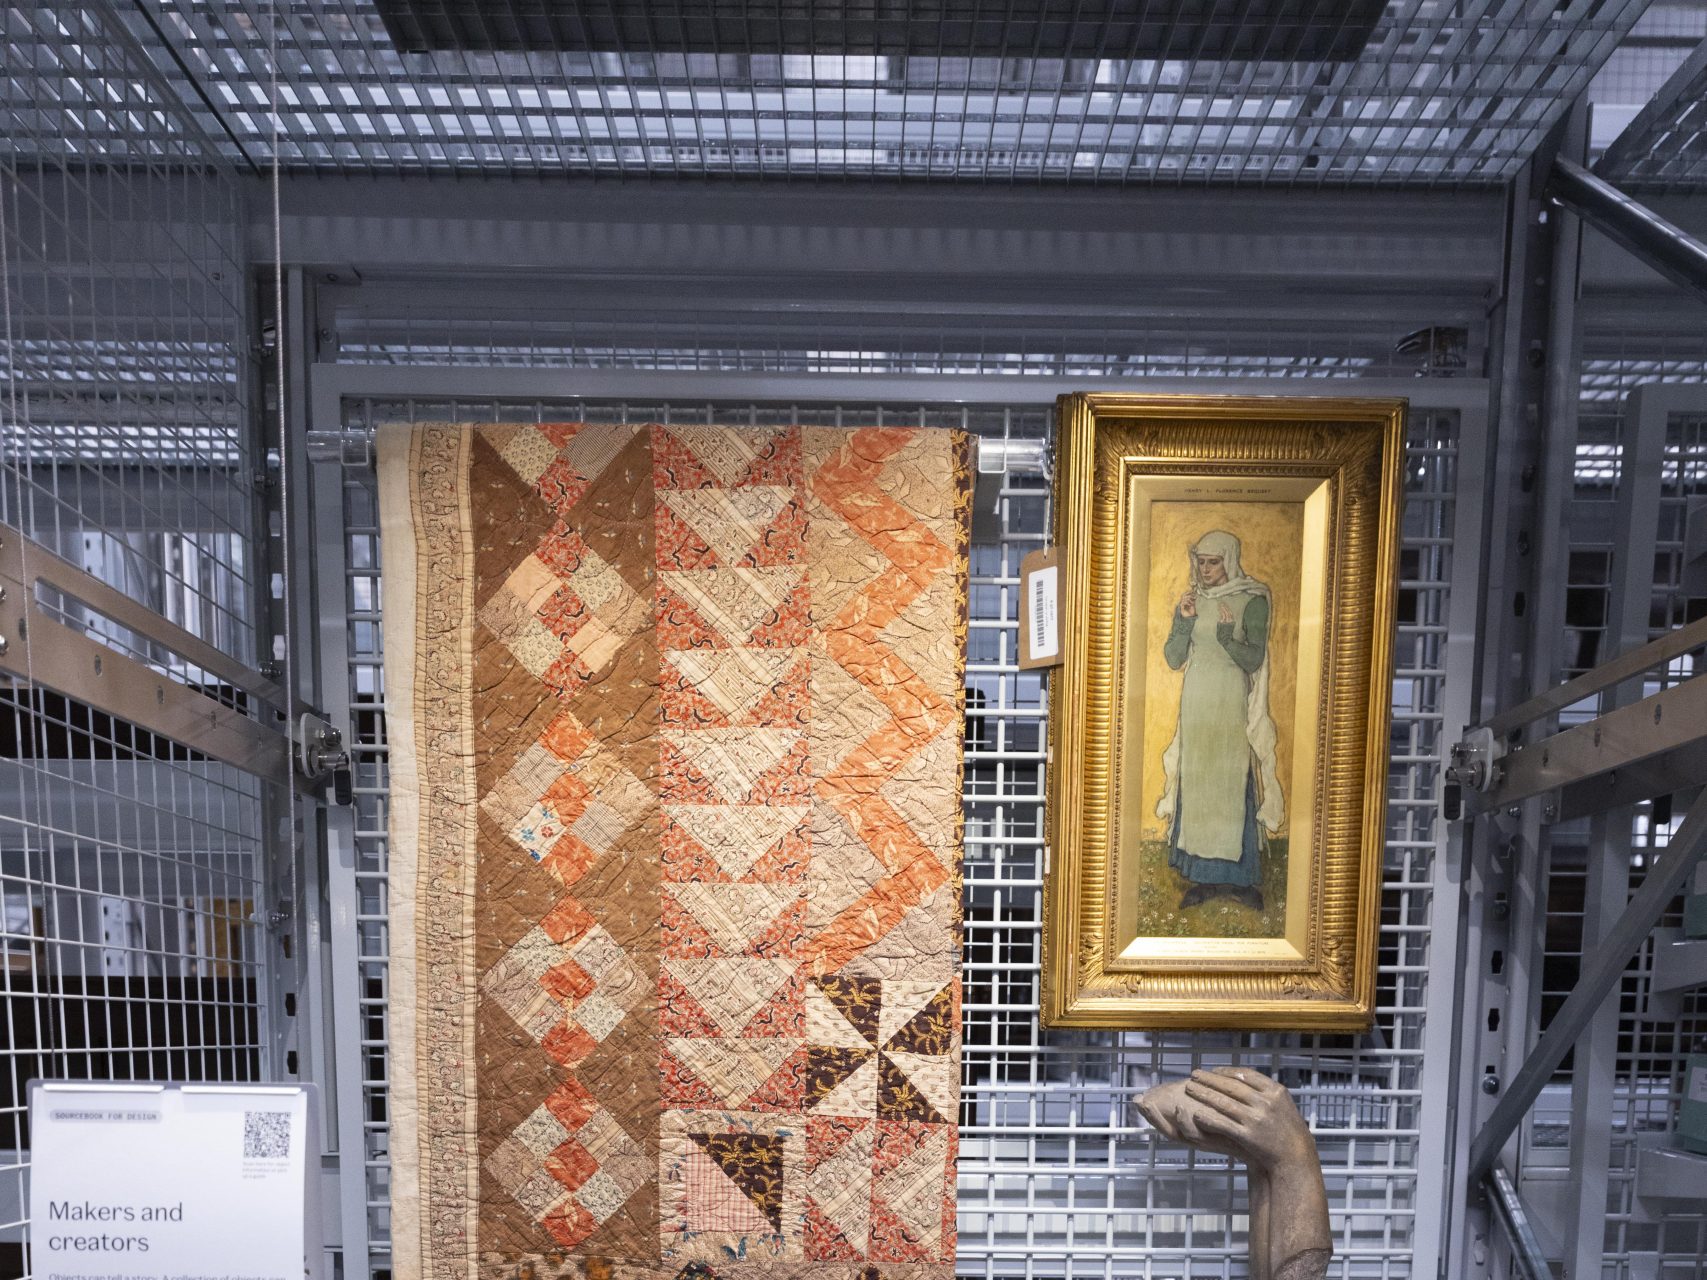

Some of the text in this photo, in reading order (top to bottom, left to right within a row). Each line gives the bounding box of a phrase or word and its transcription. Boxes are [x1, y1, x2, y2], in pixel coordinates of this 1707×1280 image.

[55, 1112, 157, 1121] SOURCEBOOK FOR DESIGN
[49, 1200, 183, 1222] Makers and
[49, 1233, 149, 1252] creators
